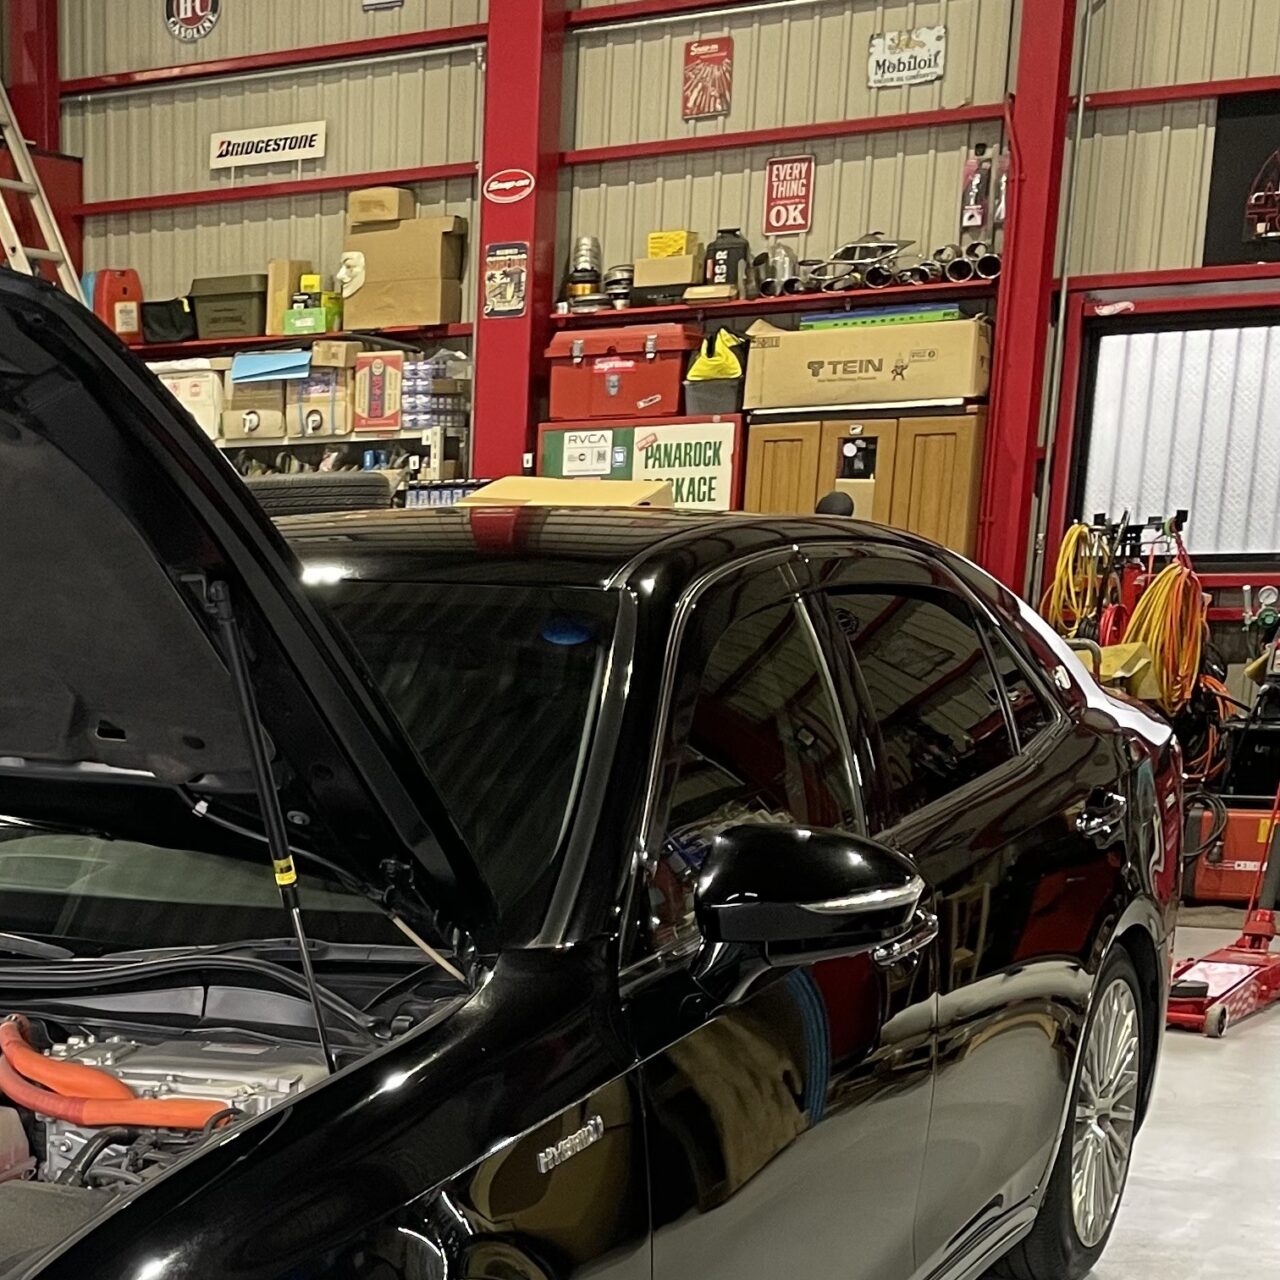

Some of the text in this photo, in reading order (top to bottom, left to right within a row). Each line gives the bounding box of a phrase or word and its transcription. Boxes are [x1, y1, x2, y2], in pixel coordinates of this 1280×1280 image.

[167, 14, 218, 39] GASOLINE
[216, 133, 319, 159] BRIDGESTONE
[771, 162, 809, 182] EVERY
[771, 179, 807, 199] THING
[768, 203, 806, 228] OK
[827, 358, 884, 376] TEIN
[568, 434, 608, 445] RVCA
[644, 440, 722, 469] PANAROCK
